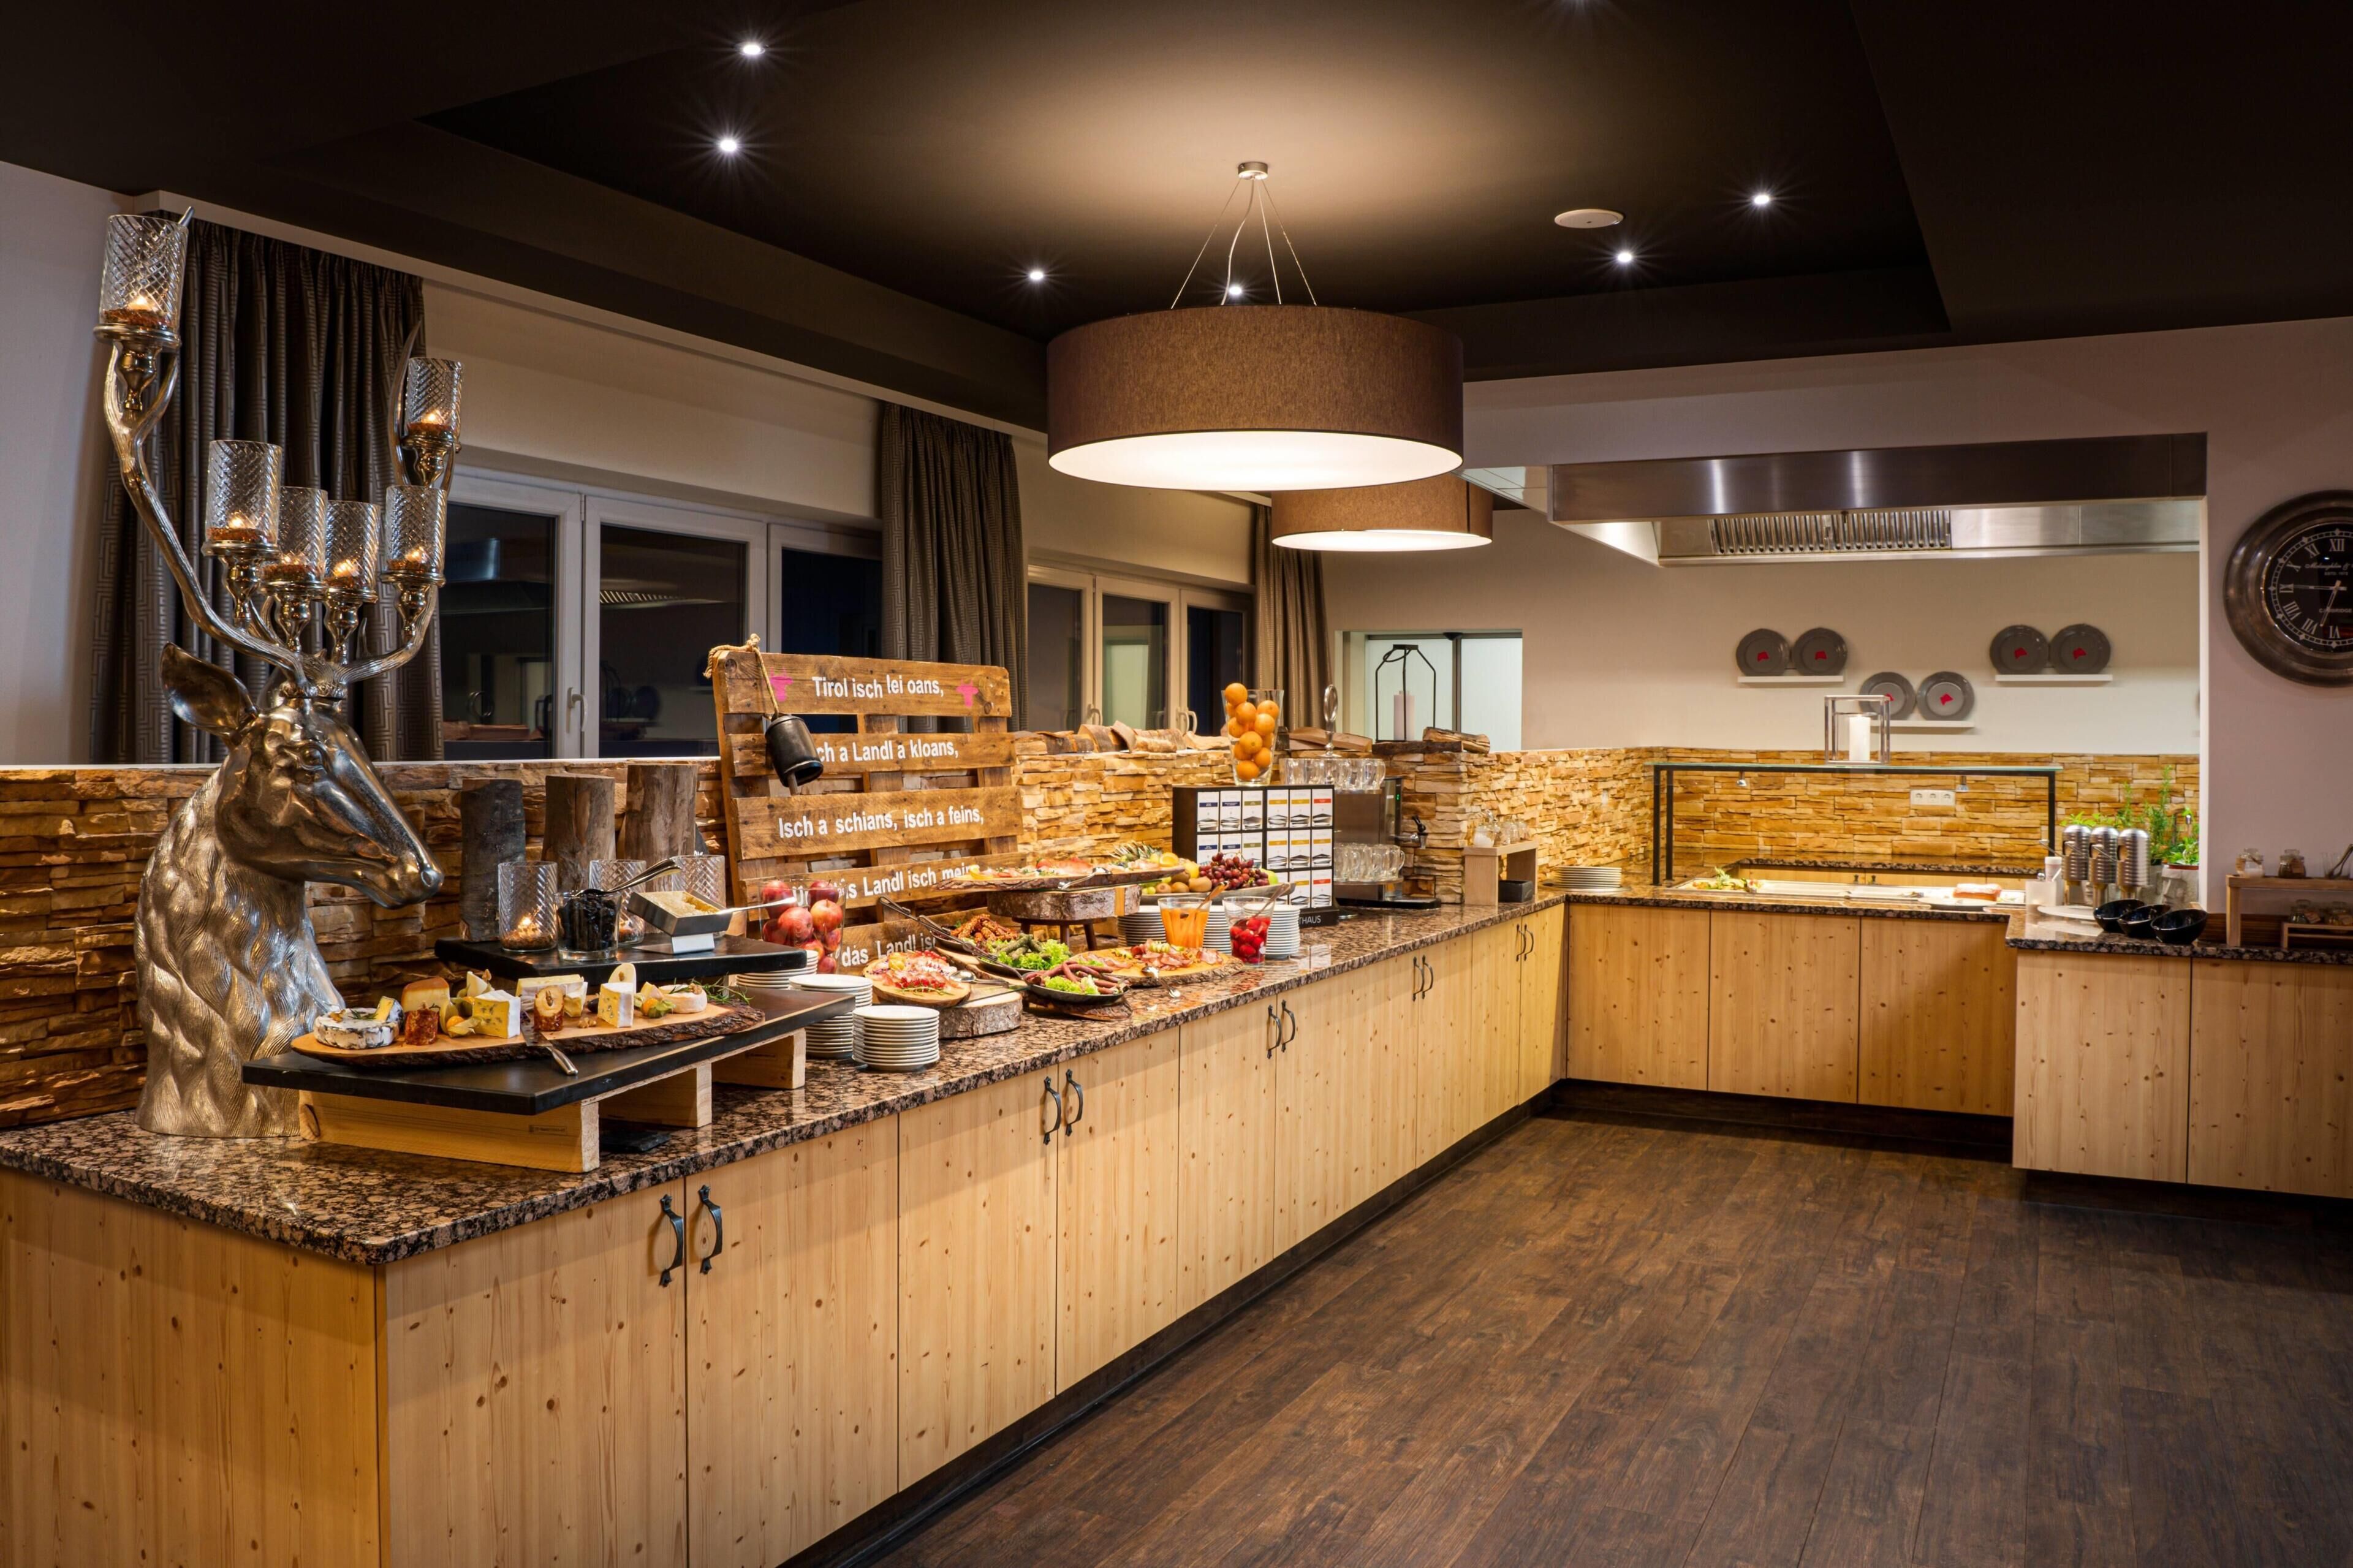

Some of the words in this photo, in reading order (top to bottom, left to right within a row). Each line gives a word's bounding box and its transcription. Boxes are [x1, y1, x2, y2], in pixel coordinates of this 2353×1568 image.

[812, 676, 848, 697] Tirol
[852, 678, 883, 699] isch
[886, 674, 903, 694] lei
[907, 679, 944, 697] oans,
[816, 741, 835, 762] ch
[839, 746, 849, 762] a
[852, 740, 893, 762] Landl
[897, 744, 906, 759] a
[909, 739, 958, 759] kloans,
[779, 816, 814, 839] Isch
[818, 818, 828, 835] a
[835, 811, 898, 834] schians,
[903, 808, 933, 828] isch
[936, 811, 945, 825] a
[949, 805, 984, 825] feins,
[863, 871, 904, 897] Landl
[907, 867, 937, 888] isch
[1299, 915, 1321, 925] THAUS
[877, 934, 916, 960] Landl
